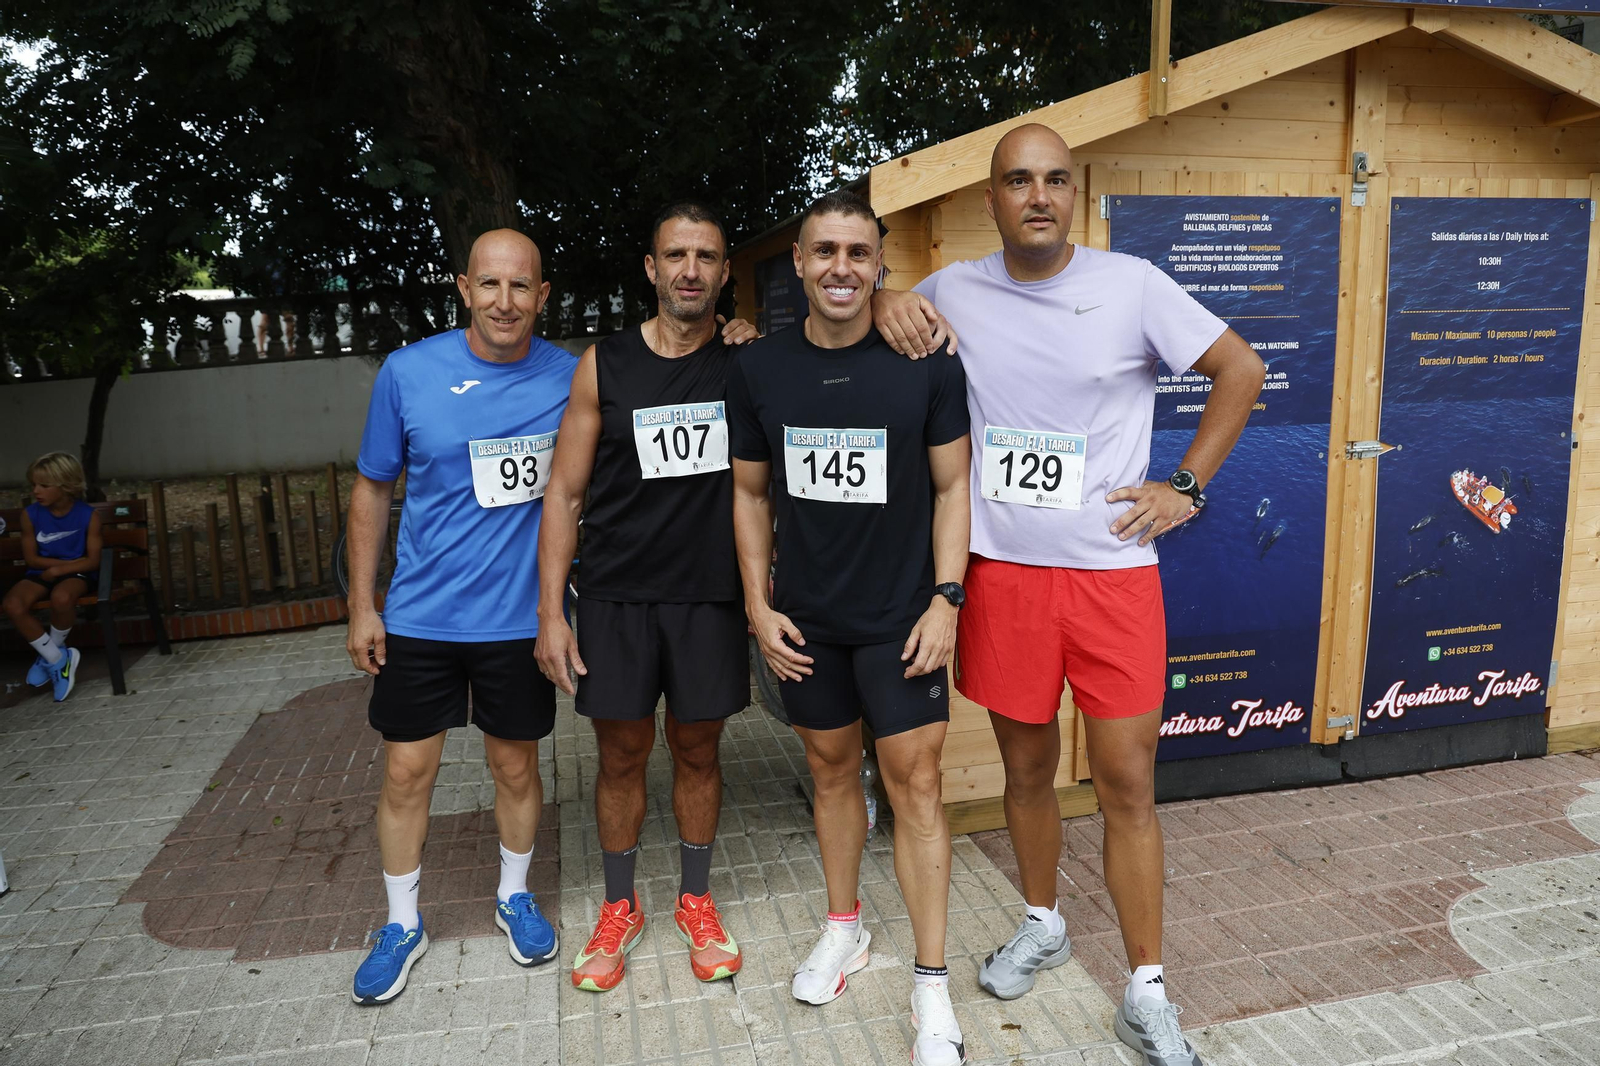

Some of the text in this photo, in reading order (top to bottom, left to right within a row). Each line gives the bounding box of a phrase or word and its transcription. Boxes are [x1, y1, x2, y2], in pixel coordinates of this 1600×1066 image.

[1185, 213, 1229, 221] AVISTAMIENTO
[1183, 224, 1216, 232] BALLENAS,
[1431, 232, 1457, 241] Salidas
[1458, 232, 1481, 241] diarias
[1489, 232, 1499, 240] las
[1501, 232, 1504, 240] /
[1505, 232, 1522, 243] Daily
[1524, 232, 1539, 242] trips
[1540, 232, 1549, 240] at:
[1171, 244, 1214, 252] Acompañados
[1233, 244, 1247, 252] viaje
[1249, 244, 1281, 252] respetuoso
[1478, 257, 1501, 265] 10:30H
[1249, 284, 1284, 292] responsable
[1477, 281, 1499, 290] 12:30H
[1411, 328, 1556, 341] Maximo / Maximum: 10 personas / people
[1420, 353, 1544, 366] Duracion / Duration: 2 horas / hours
[1155, 385, 1190, 393] SCIENTISTS
[1261, 382, 1289, 390] LOGISTS
[673, 408, 693, 425] ELA
[693, 408, 718, 421] TARIFA
[511, 440, 532, 456] ELA
[532, 438, 553, 451] TARIFA
[652, 424, 710, 462] 107
[827, 433, 847, 449] ELA
[848, 435, 876, 448] TARIFA
[1025, 435, 1046, 452] ELA
[1048, 439, 1076, 453] TARIFA
[500, 455, 538, 490] 93
[803, 450, 866, 487] 145
[999, 450, 1062, 492] 129
[1426, 623, 1502, 637] www.aventuratarifa.com
[1168, 649, 1256, 663] www.aventuratarifa.com
[1443, 643, 1494, 656] +34 634 522 738
[1190, 671, 1248, 683] +34 634 522 738
[1367, 669, 1542, 719] Aventura Tarifa
[1159, 699, 1304, 738] ntura Tarifa
